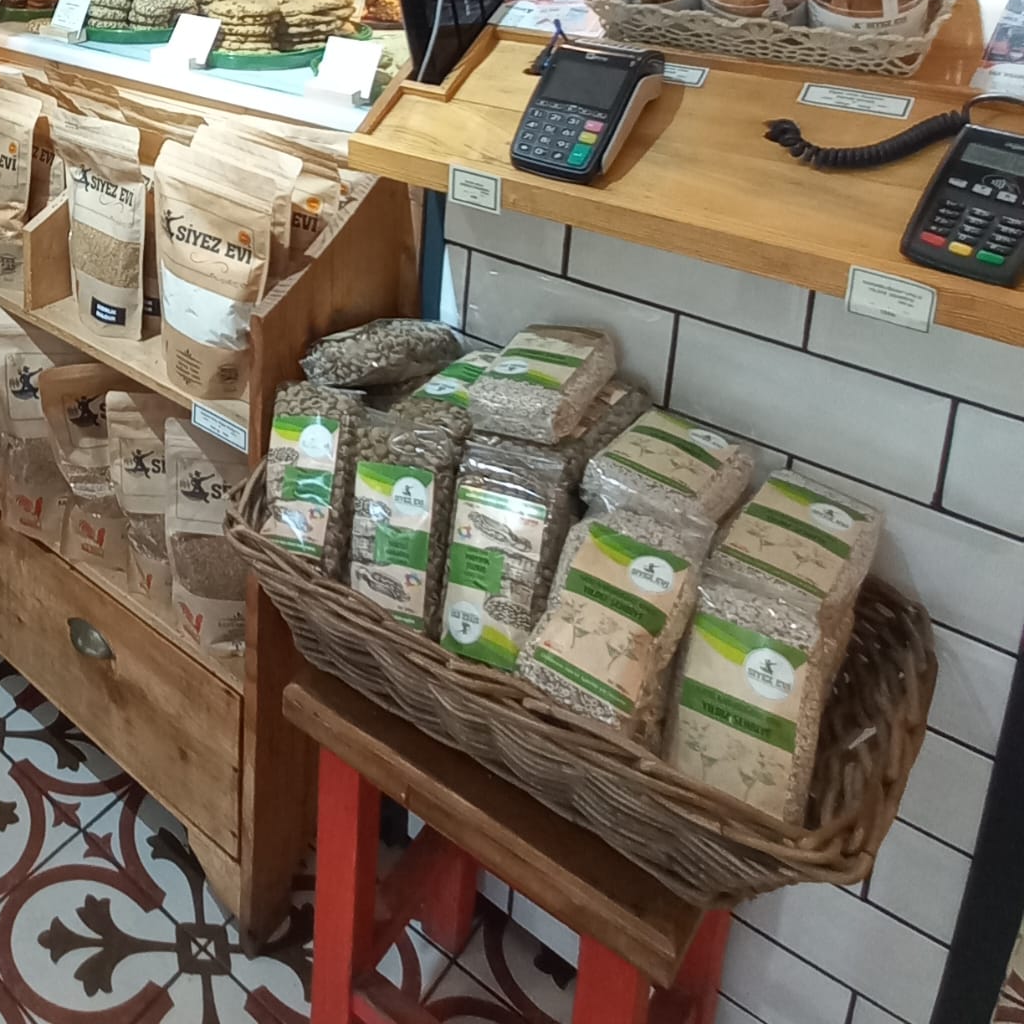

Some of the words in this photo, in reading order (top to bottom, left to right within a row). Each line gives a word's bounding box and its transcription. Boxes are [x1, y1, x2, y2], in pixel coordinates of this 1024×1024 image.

[90, 175, 119, 198] SİYEZ
[119, 187, 134, 207] EVİ
[292, 212, 319, 233] EVİ
[176, 223, 222, 254] SİYEZ
[226, 241, 252, 265] EVİ
